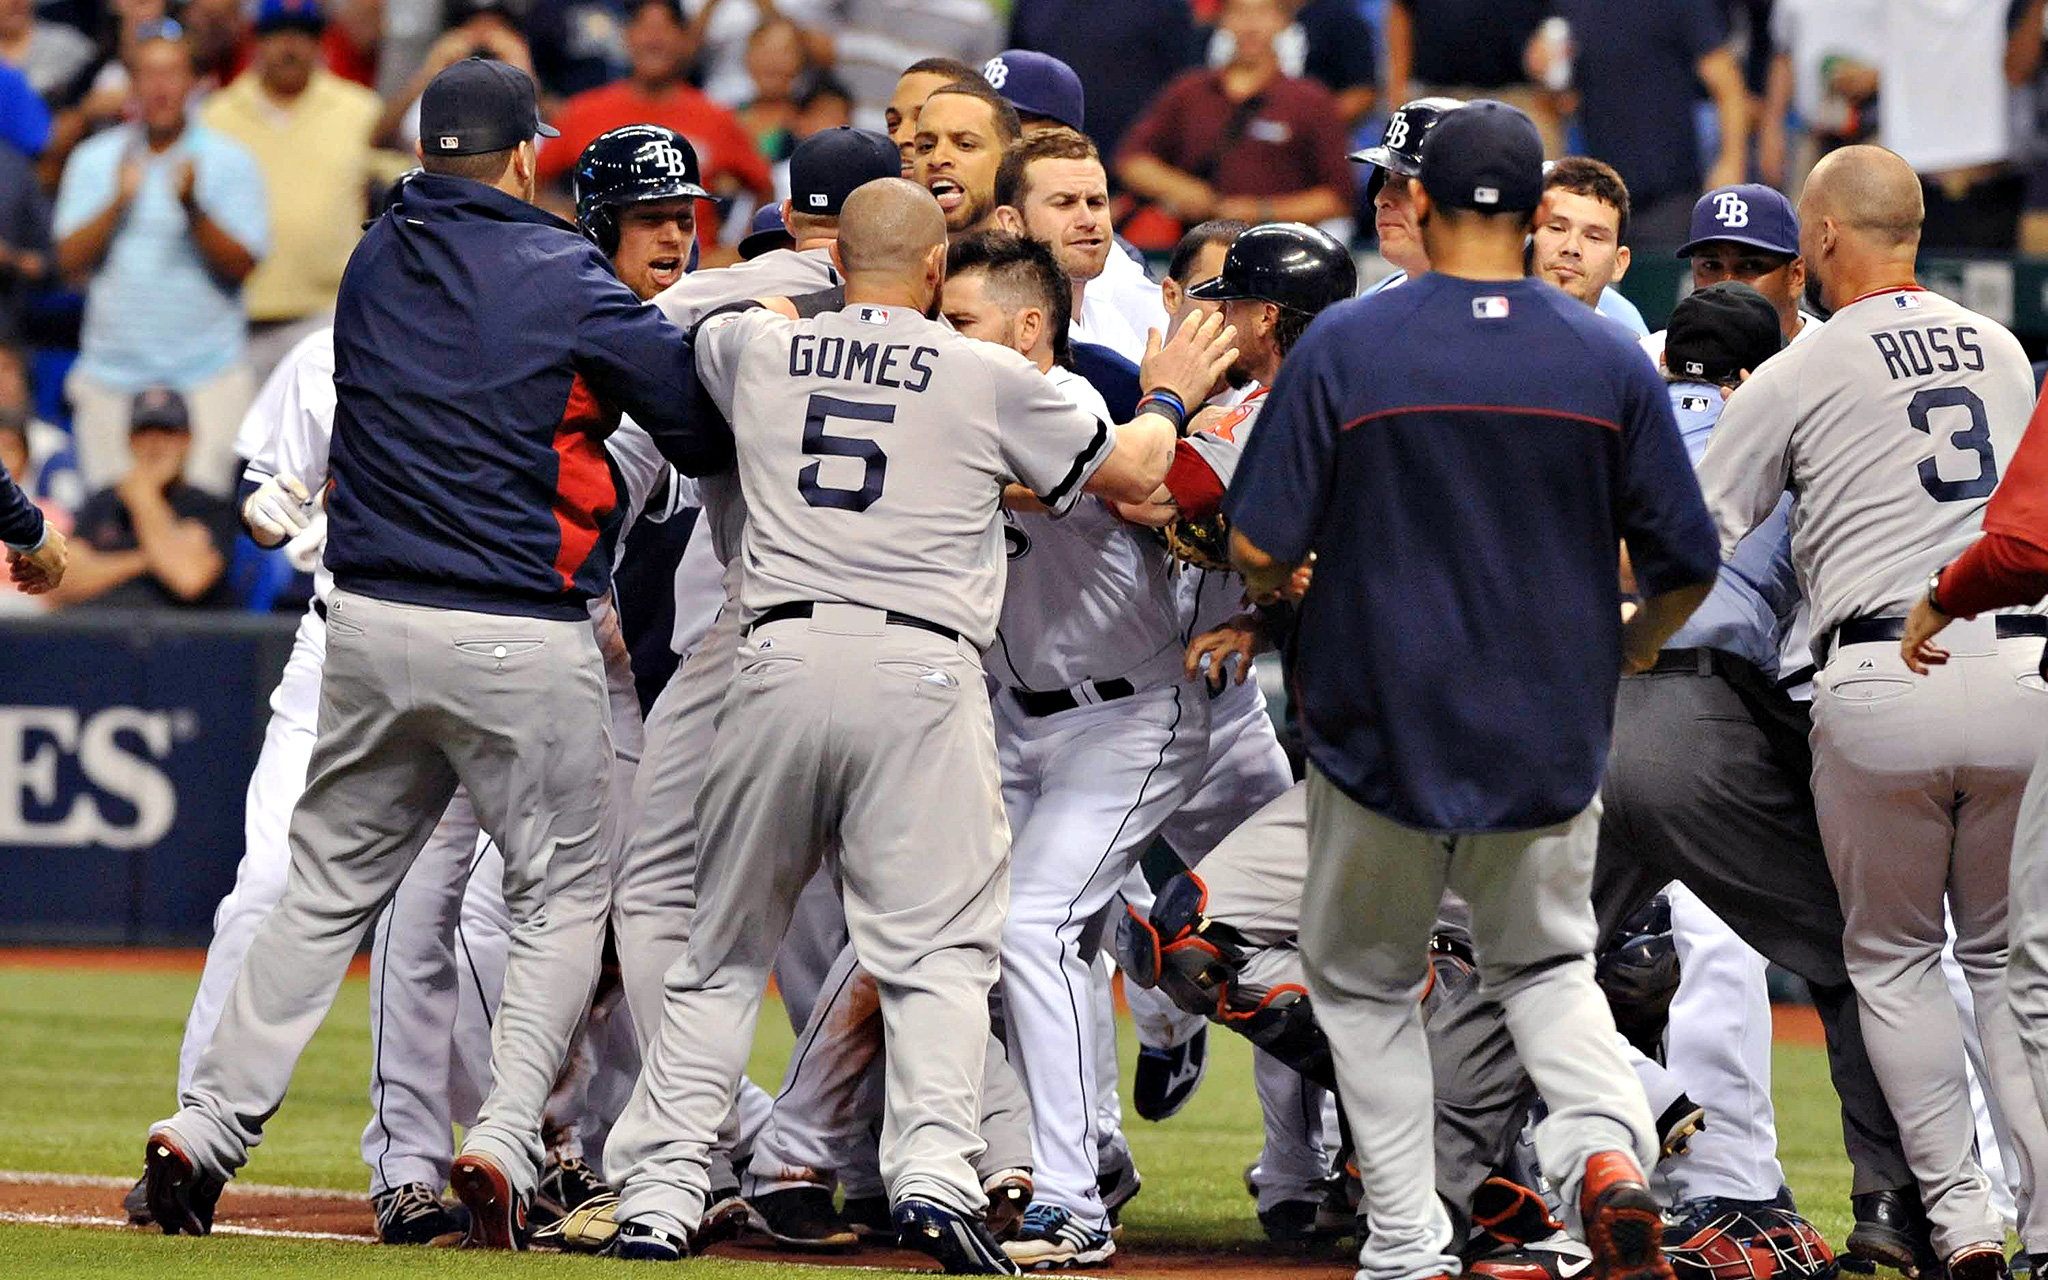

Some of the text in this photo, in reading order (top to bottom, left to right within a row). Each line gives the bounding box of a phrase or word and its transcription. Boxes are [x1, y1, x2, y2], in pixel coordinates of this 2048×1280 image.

[645, 140, 686, 177] TB
[1713, 192, 1749, 228] TB
[789, 334, 940, 393] GOMES
[1871, 326, 1985, 380] ROSS
[798, 394, 897, 513] 5
[1907, 386, 1999, 503] 3
[0, 704, 177, 850] ES
